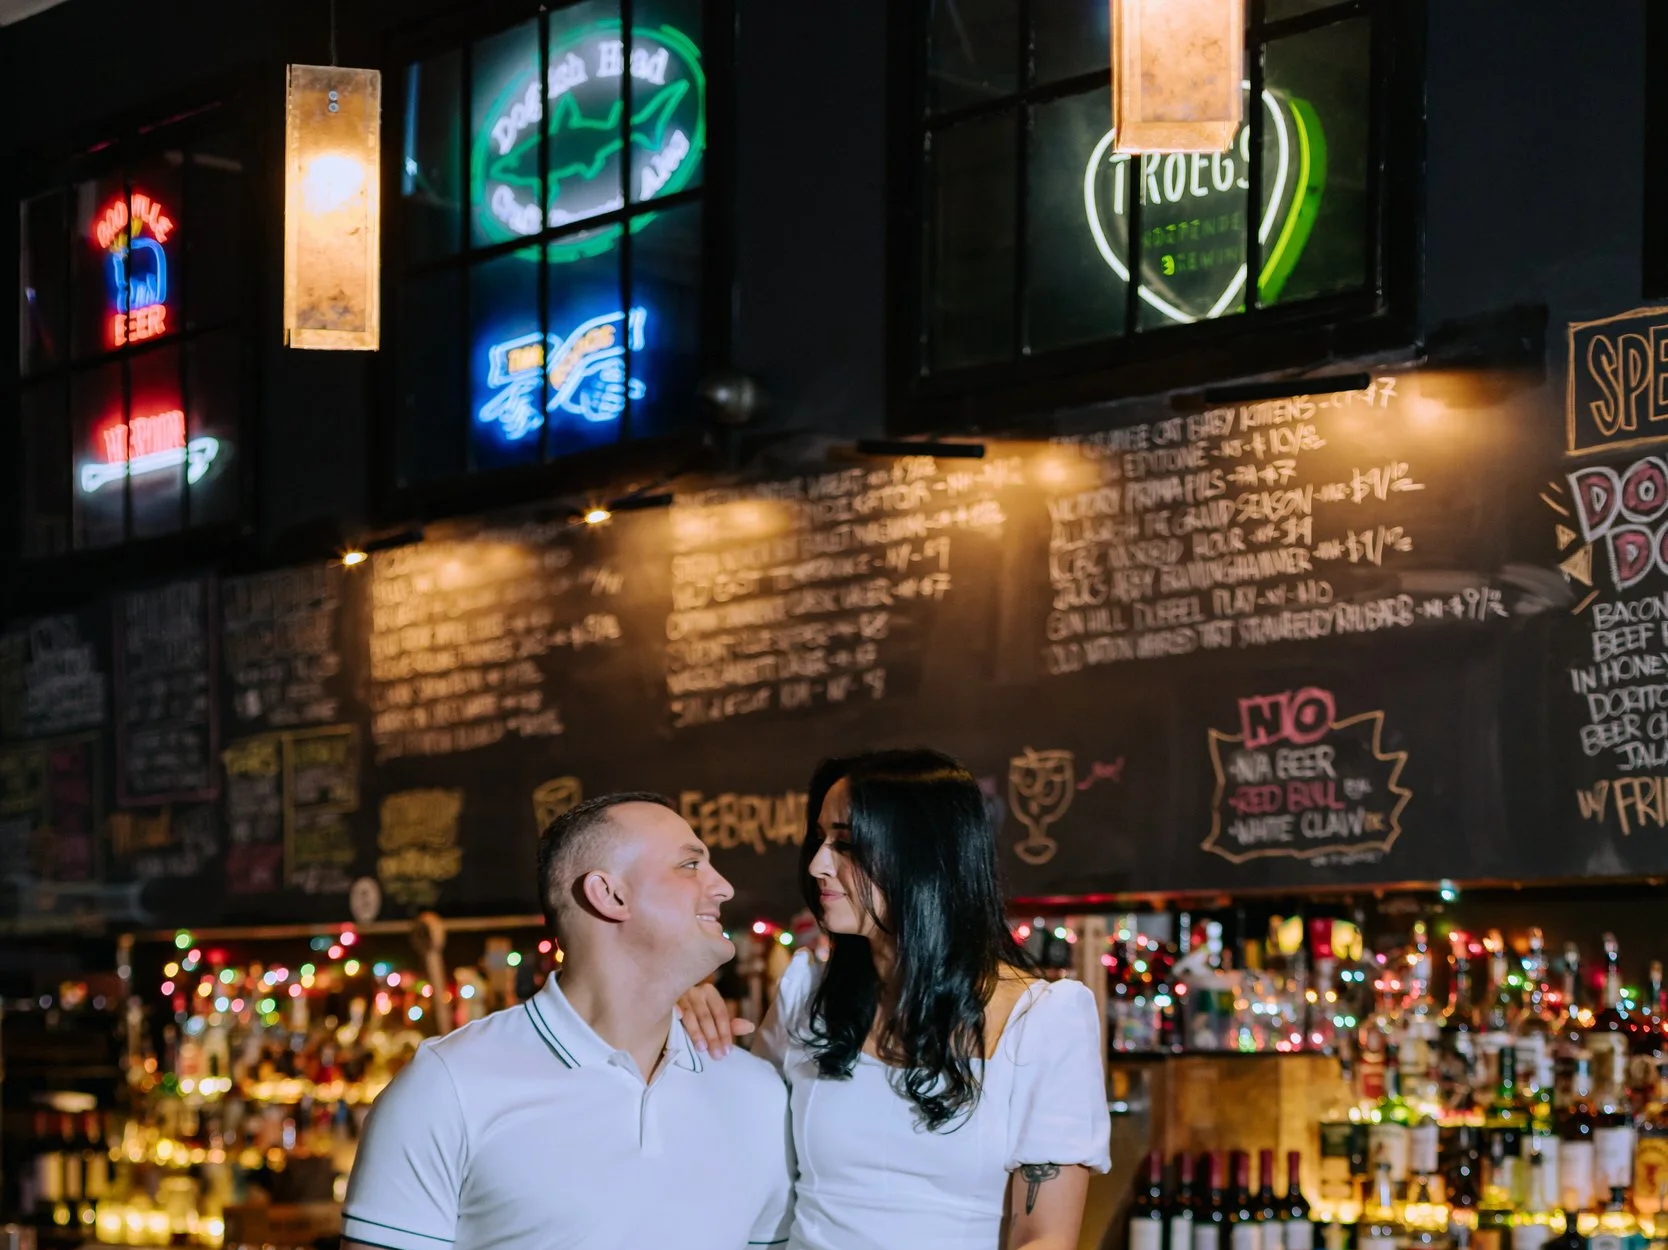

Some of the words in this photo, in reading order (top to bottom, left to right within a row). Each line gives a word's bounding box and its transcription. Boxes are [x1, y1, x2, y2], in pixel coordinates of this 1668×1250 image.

[596, 40, 669, 85] Had
[1592, 622, 1655, 662] BEEF
[1571, 665, 1597, 694] IN
[1238, 686, 1337, 750] NO
[1580, 714, 1642, 757] BEER
[1275, 745, 1337, 780] BEER
[680, 791, 809, 856] FEBRUA
[1301, 806, 1366, 839] CLAW
